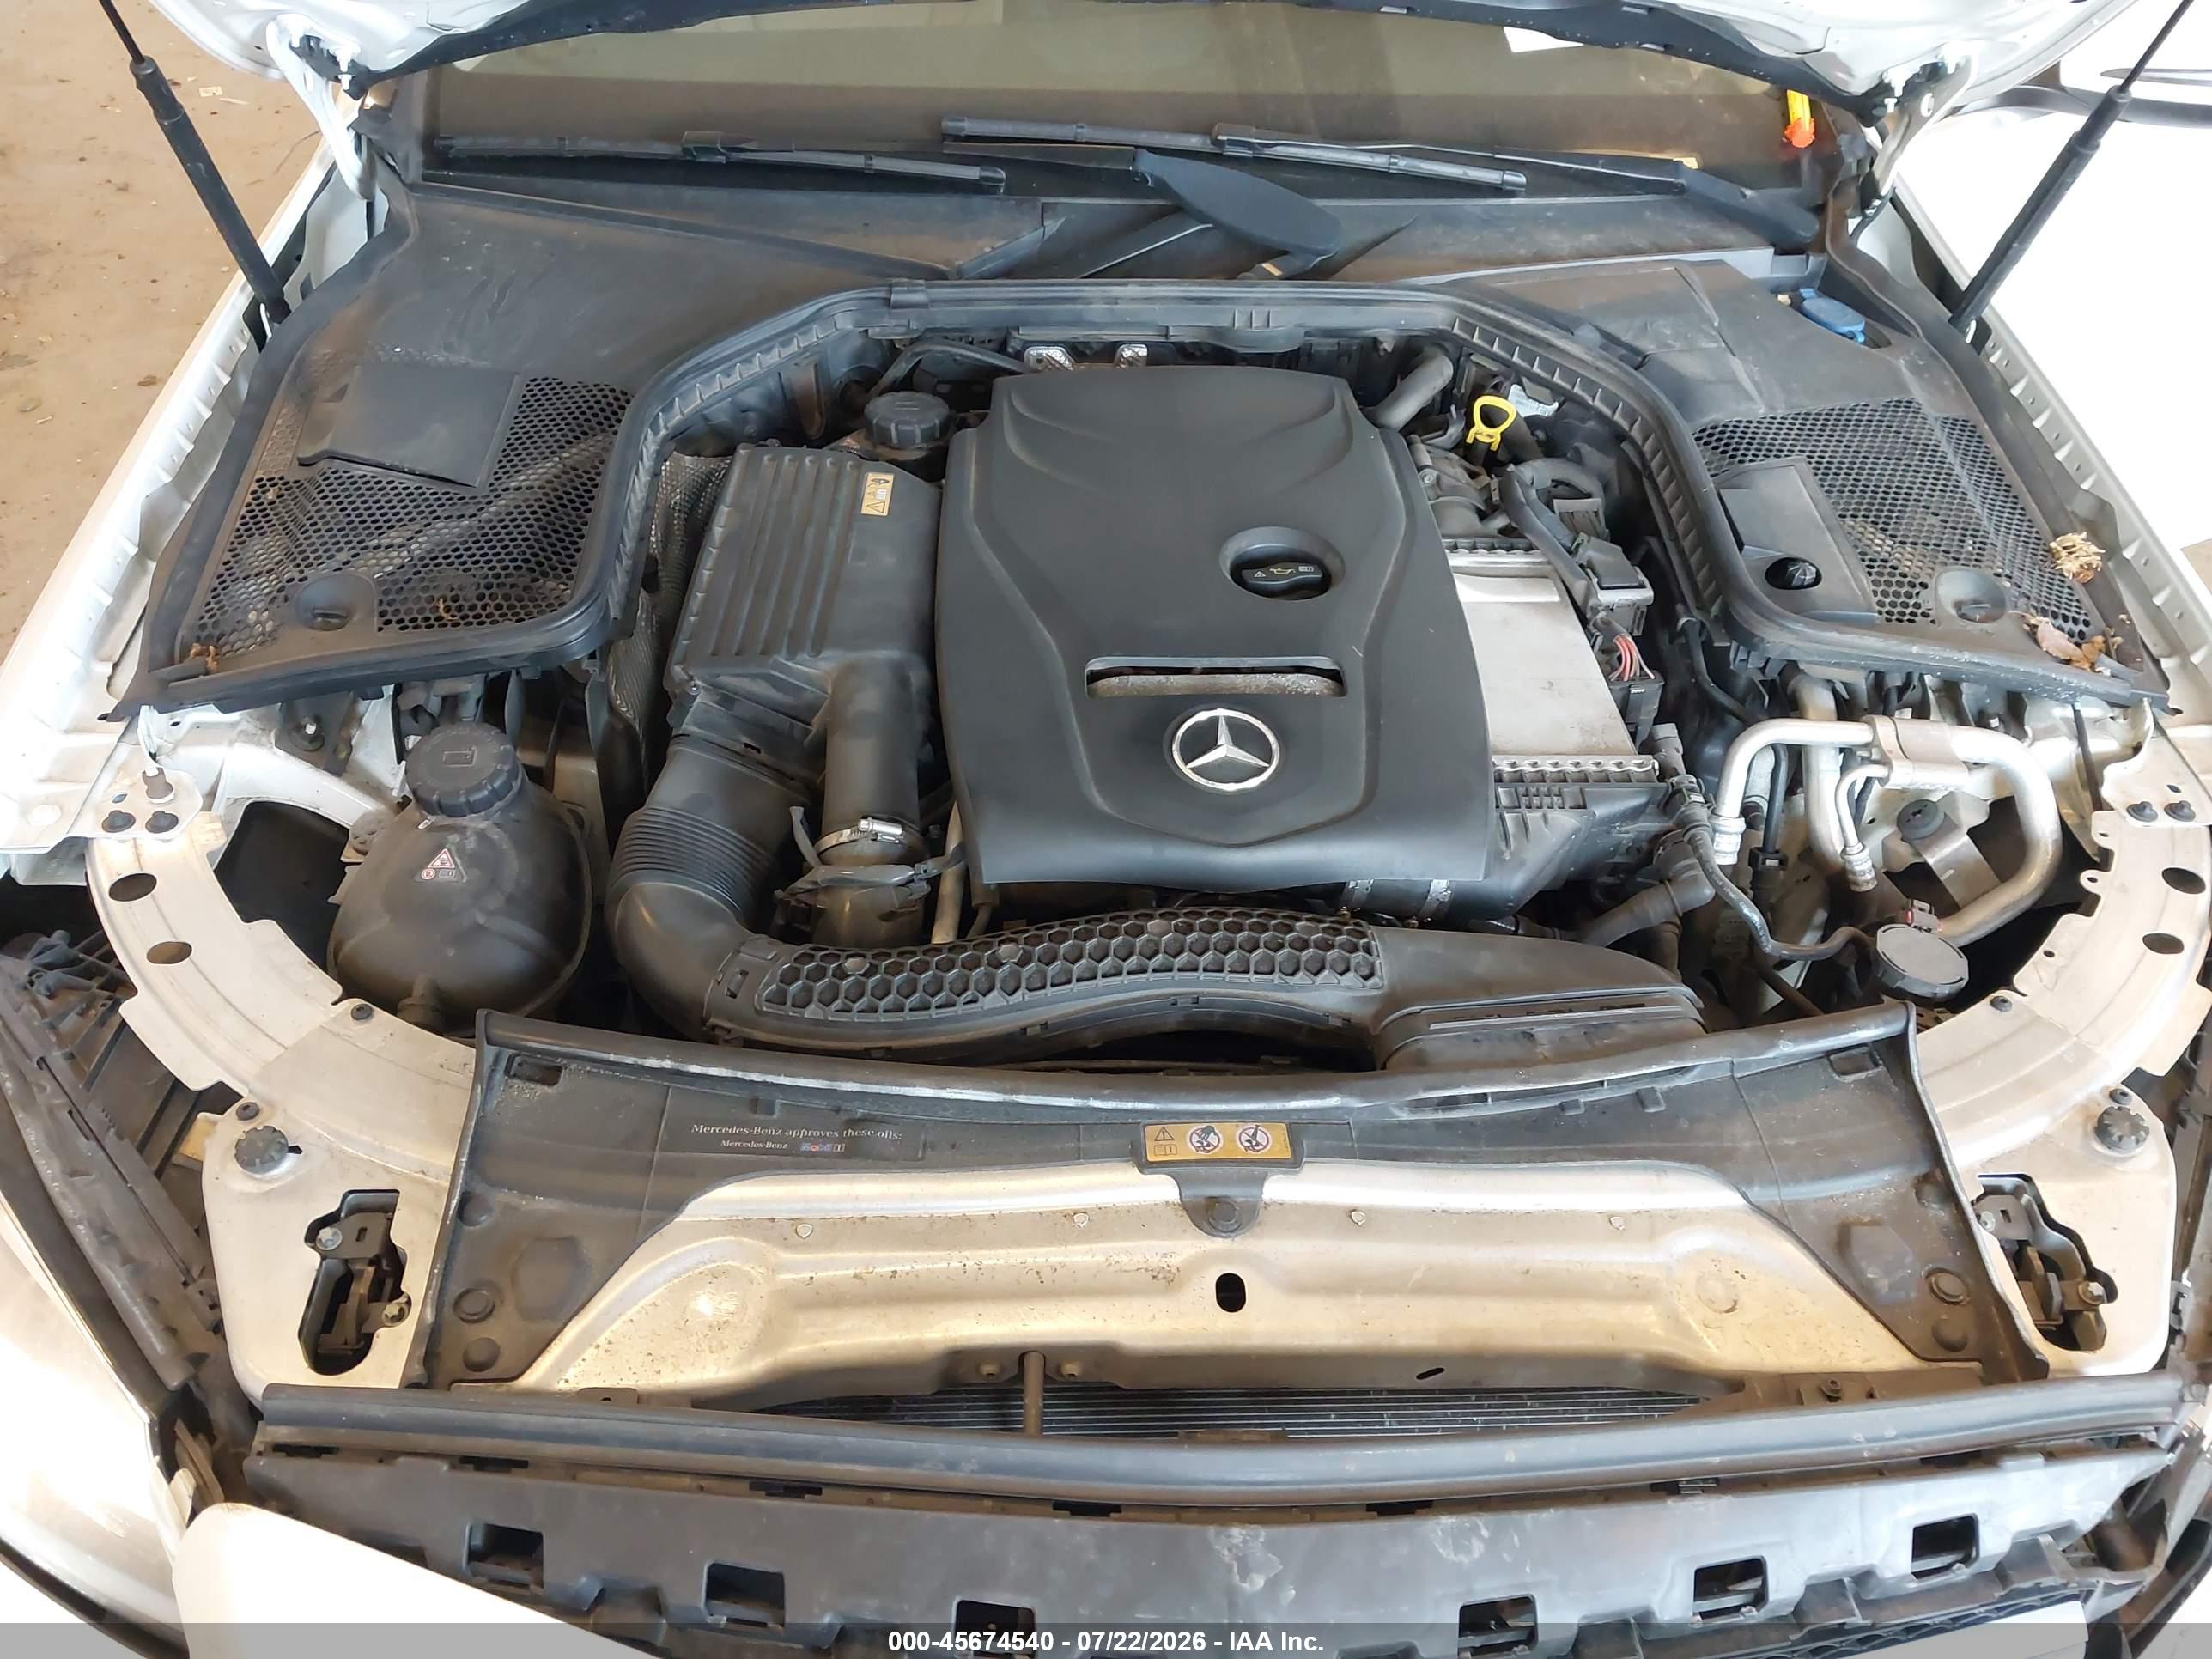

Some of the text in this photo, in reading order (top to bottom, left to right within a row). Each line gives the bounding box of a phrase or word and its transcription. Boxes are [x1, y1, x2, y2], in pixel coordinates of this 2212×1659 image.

[690, 1123, 903, 1140] Mercedes-Benz approves these oils:
[721, 1139, 788, 1149] Mercedes-Benz
